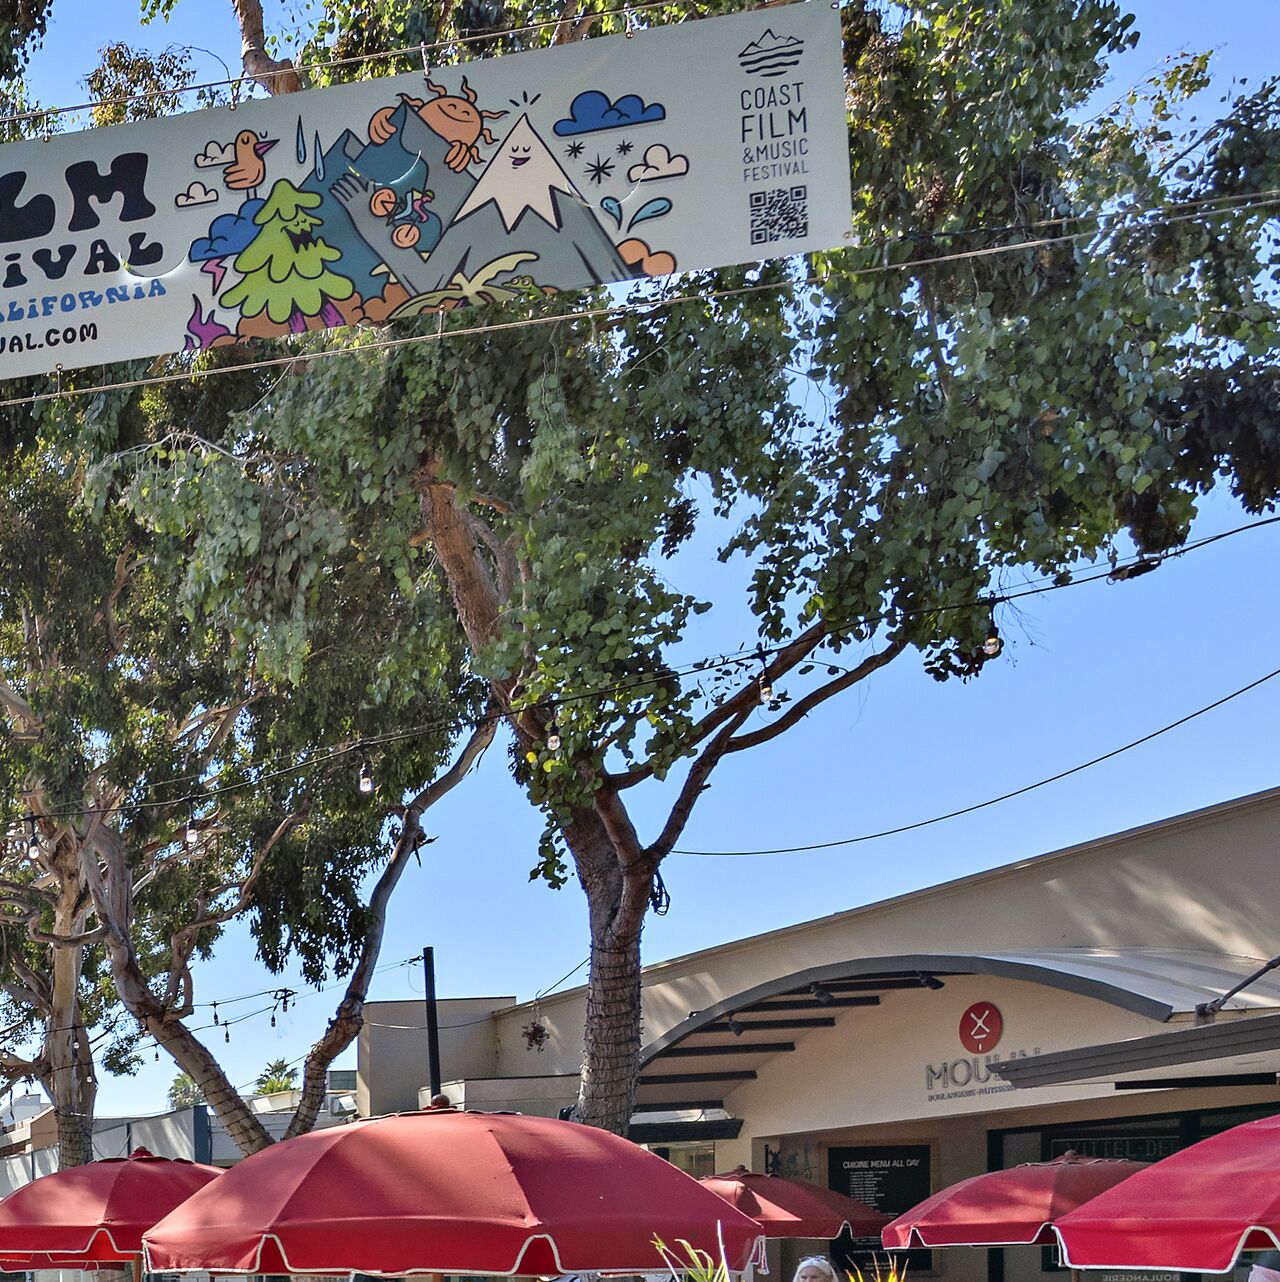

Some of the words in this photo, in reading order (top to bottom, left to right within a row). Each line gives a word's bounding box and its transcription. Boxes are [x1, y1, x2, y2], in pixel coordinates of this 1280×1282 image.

[740, 82, 804, 110] COAST
[742, 107, 807, 143] FILM
[743, 138, 808, 165] &MUSIC
[744, 160, 809, 182] FESTIVAL
[891, 1159, 905, 1167] ALL
